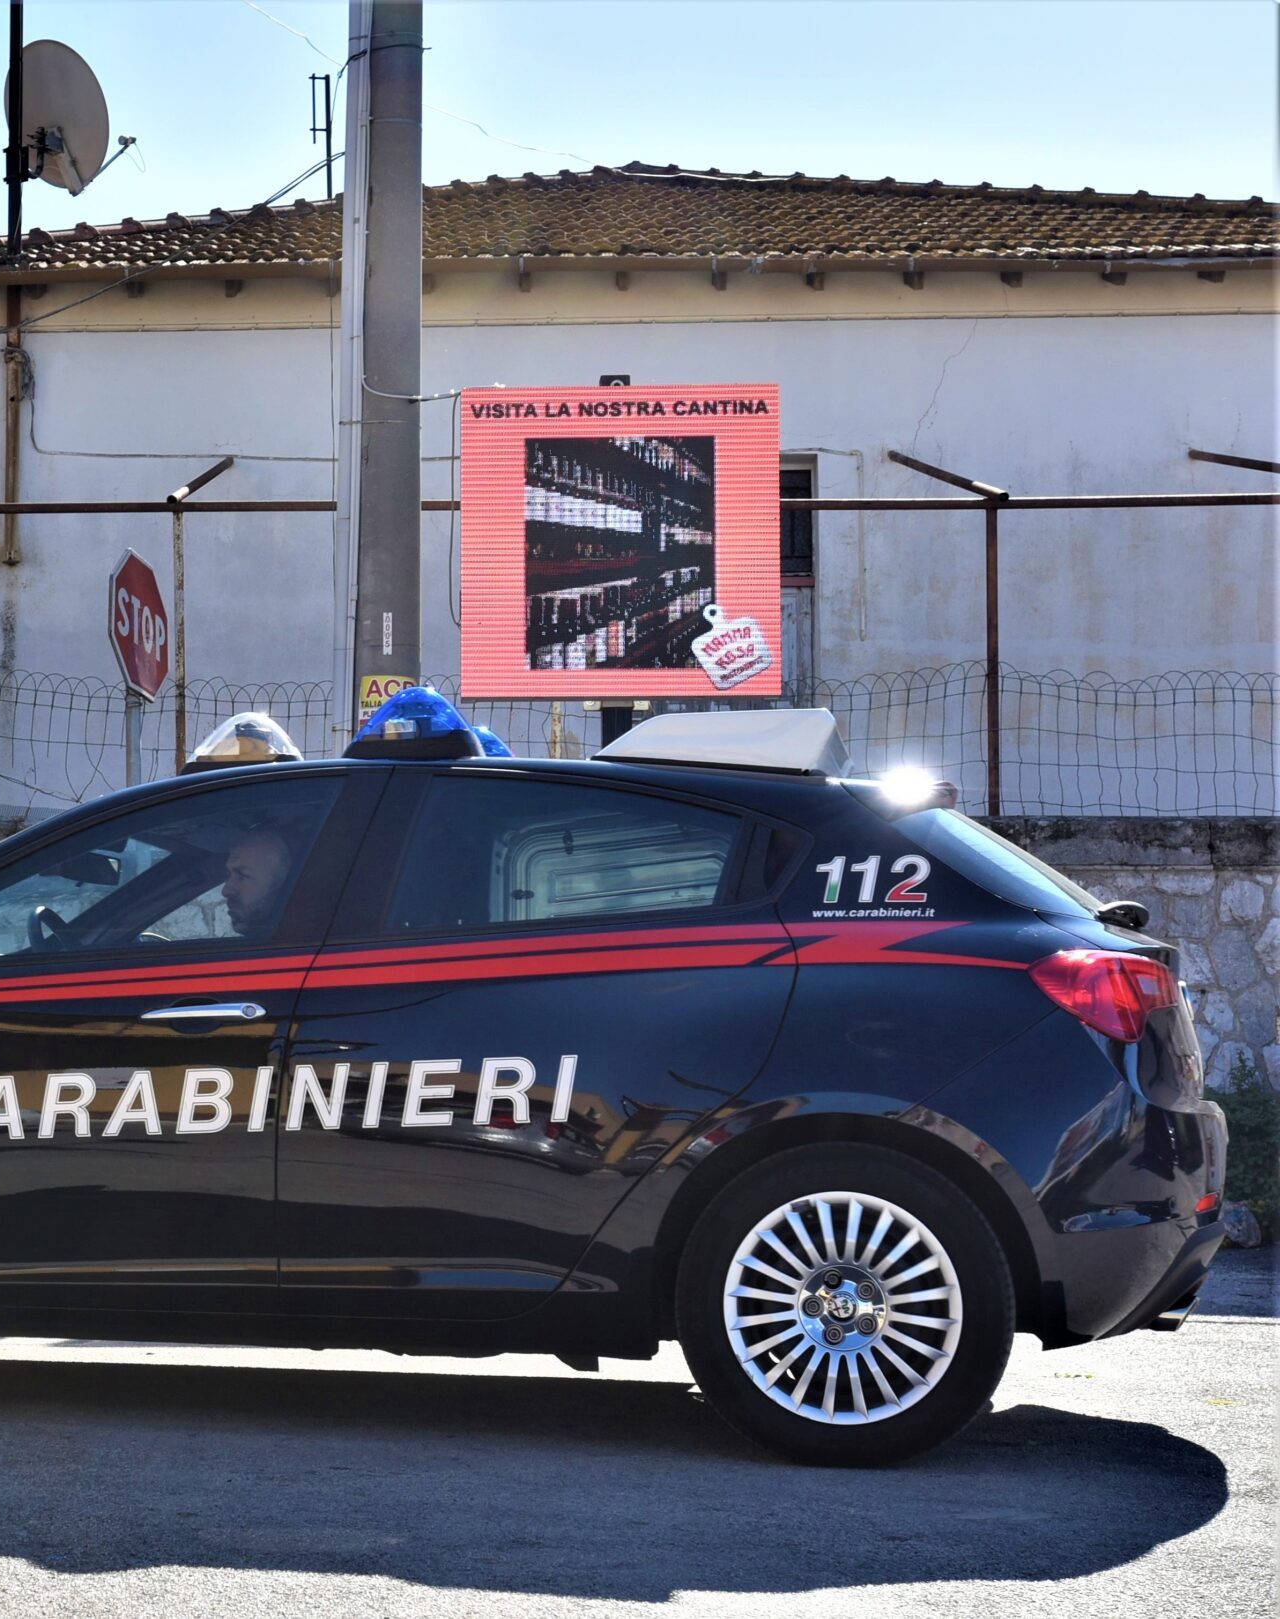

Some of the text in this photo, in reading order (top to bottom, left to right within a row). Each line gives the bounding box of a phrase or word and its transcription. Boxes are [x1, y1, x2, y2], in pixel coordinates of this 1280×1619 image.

[470, 400, 769, 419] VISITA LA NOSTRA CANTINA
[117, 587, 166, 662] STOP
[701, 627, 751, 657] MAMMA
[816, 854, 931, 904] 112
[812, 907, 935, 918] www.carabinieri.it
